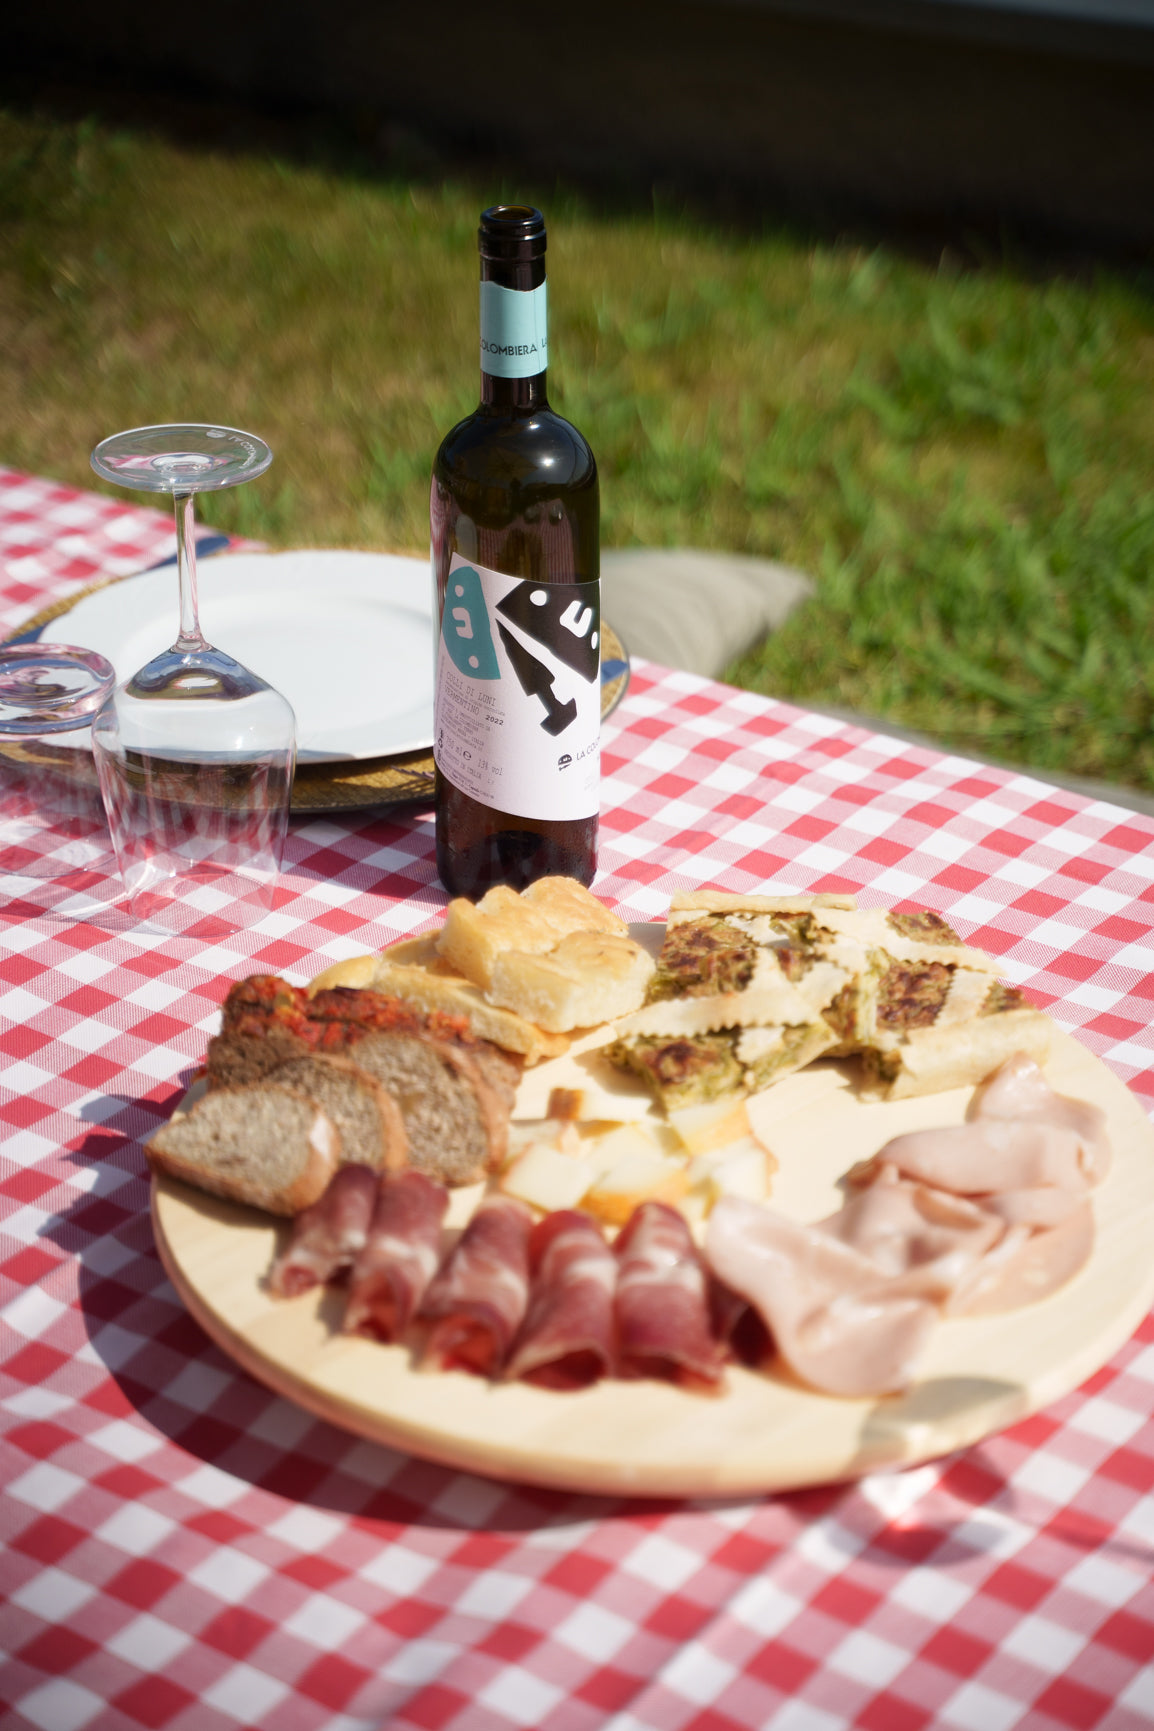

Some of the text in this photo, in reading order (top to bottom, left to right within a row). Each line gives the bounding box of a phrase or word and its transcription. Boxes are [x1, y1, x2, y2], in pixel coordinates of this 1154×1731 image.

[485, 715, 504, 726] 2022
[576, 750, 586, 761] LA
[491, 766, 503, 776] vol
